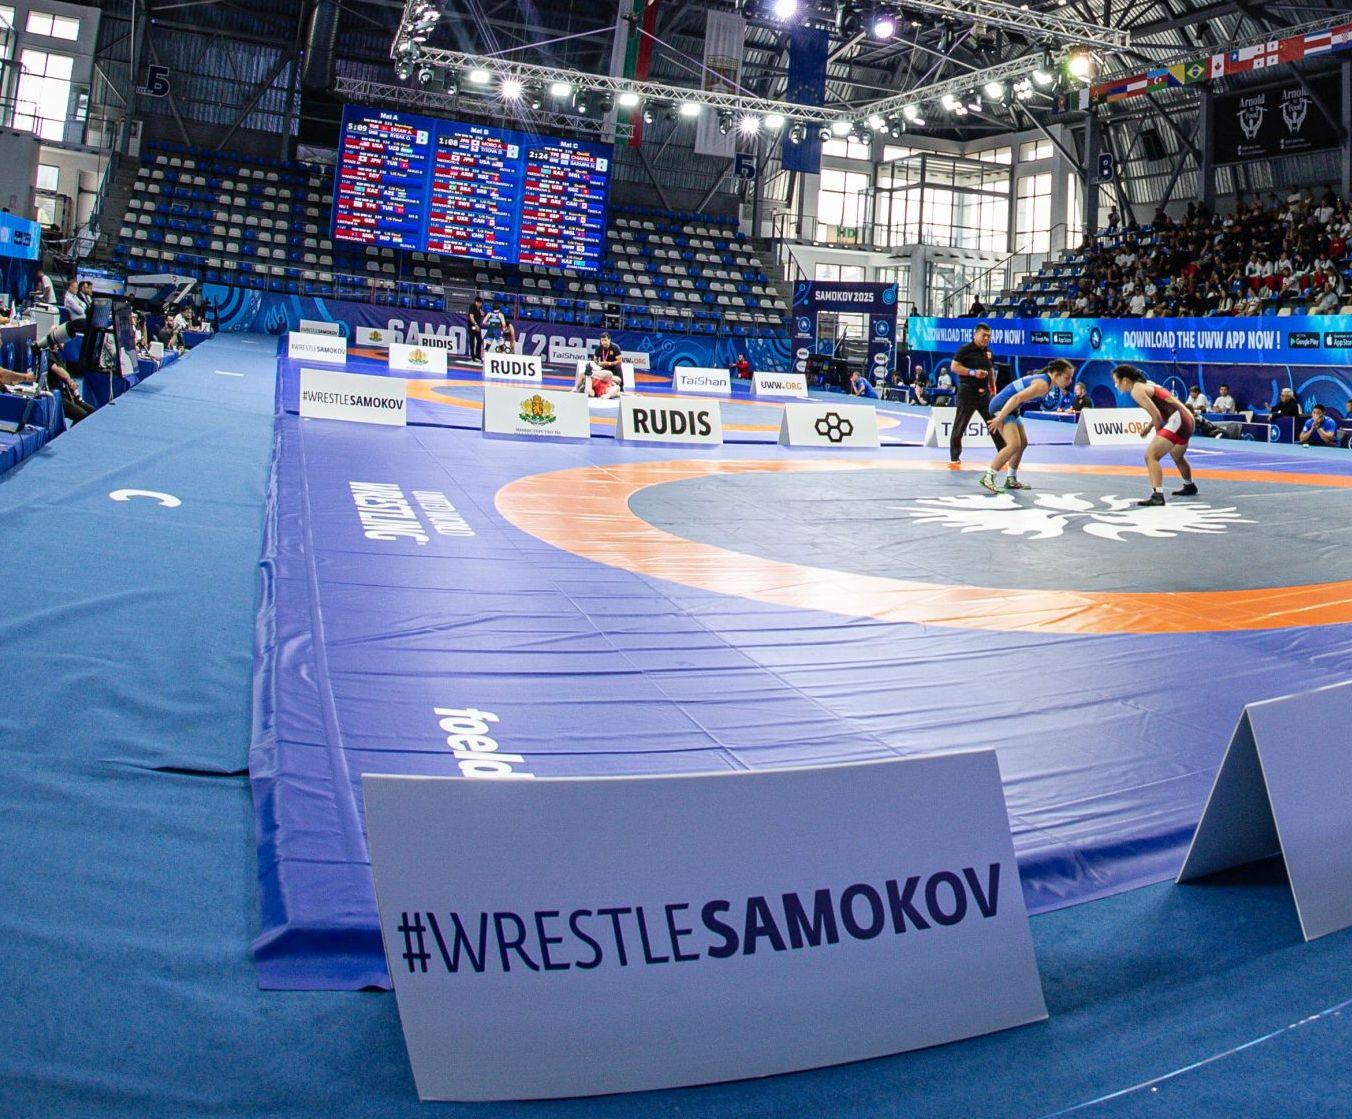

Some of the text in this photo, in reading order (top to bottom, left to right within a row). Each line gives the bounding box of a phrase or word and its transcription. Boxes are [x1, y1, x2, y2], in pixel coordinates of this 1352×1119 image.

[1283, 87, 1310, 100] Arnold
[1240, 93, 1265, 108] Arnold
[1288, 103, 1302, 112] Food
[380, 112, 392, 120] Mat
[1245, 111, 1259, 120] Food
[348, 122, 367, 132] 5:09
[439, 137, 458, 146] 1:08
[529, 151, 548, 160] 2:24
[815, 290, 874, 302] SAMOKOV 2025
[925, 327, 960, 342] DOWNLOAD
[961, 328, 973, 343] THE
[1004, 330, 1020, 344] NOW
[1124, 331, 1280, 349] DOWNLOAD THE UWW APP NOW !
[422, 338, 453, 351] RUDIS
[553, 351, 585, 360] TaiShan
[490, 359, 536, 377] RUDIS
[680, 374, 727, 387] TaiShan
[760, 380, 803, 391] UWW.ORG
[303, 390, 404, 410] #WRESTLESAMOKOV
[633, 407, 712, 436] RUDIS
[349, 480, 431, 546] WRESTLING
[412, 489, 477, 537] UNITED WORLD
[434, 706, 535, 779] foeld
[397, 862, 1000, 974] #WRESTLESAMOKOV
